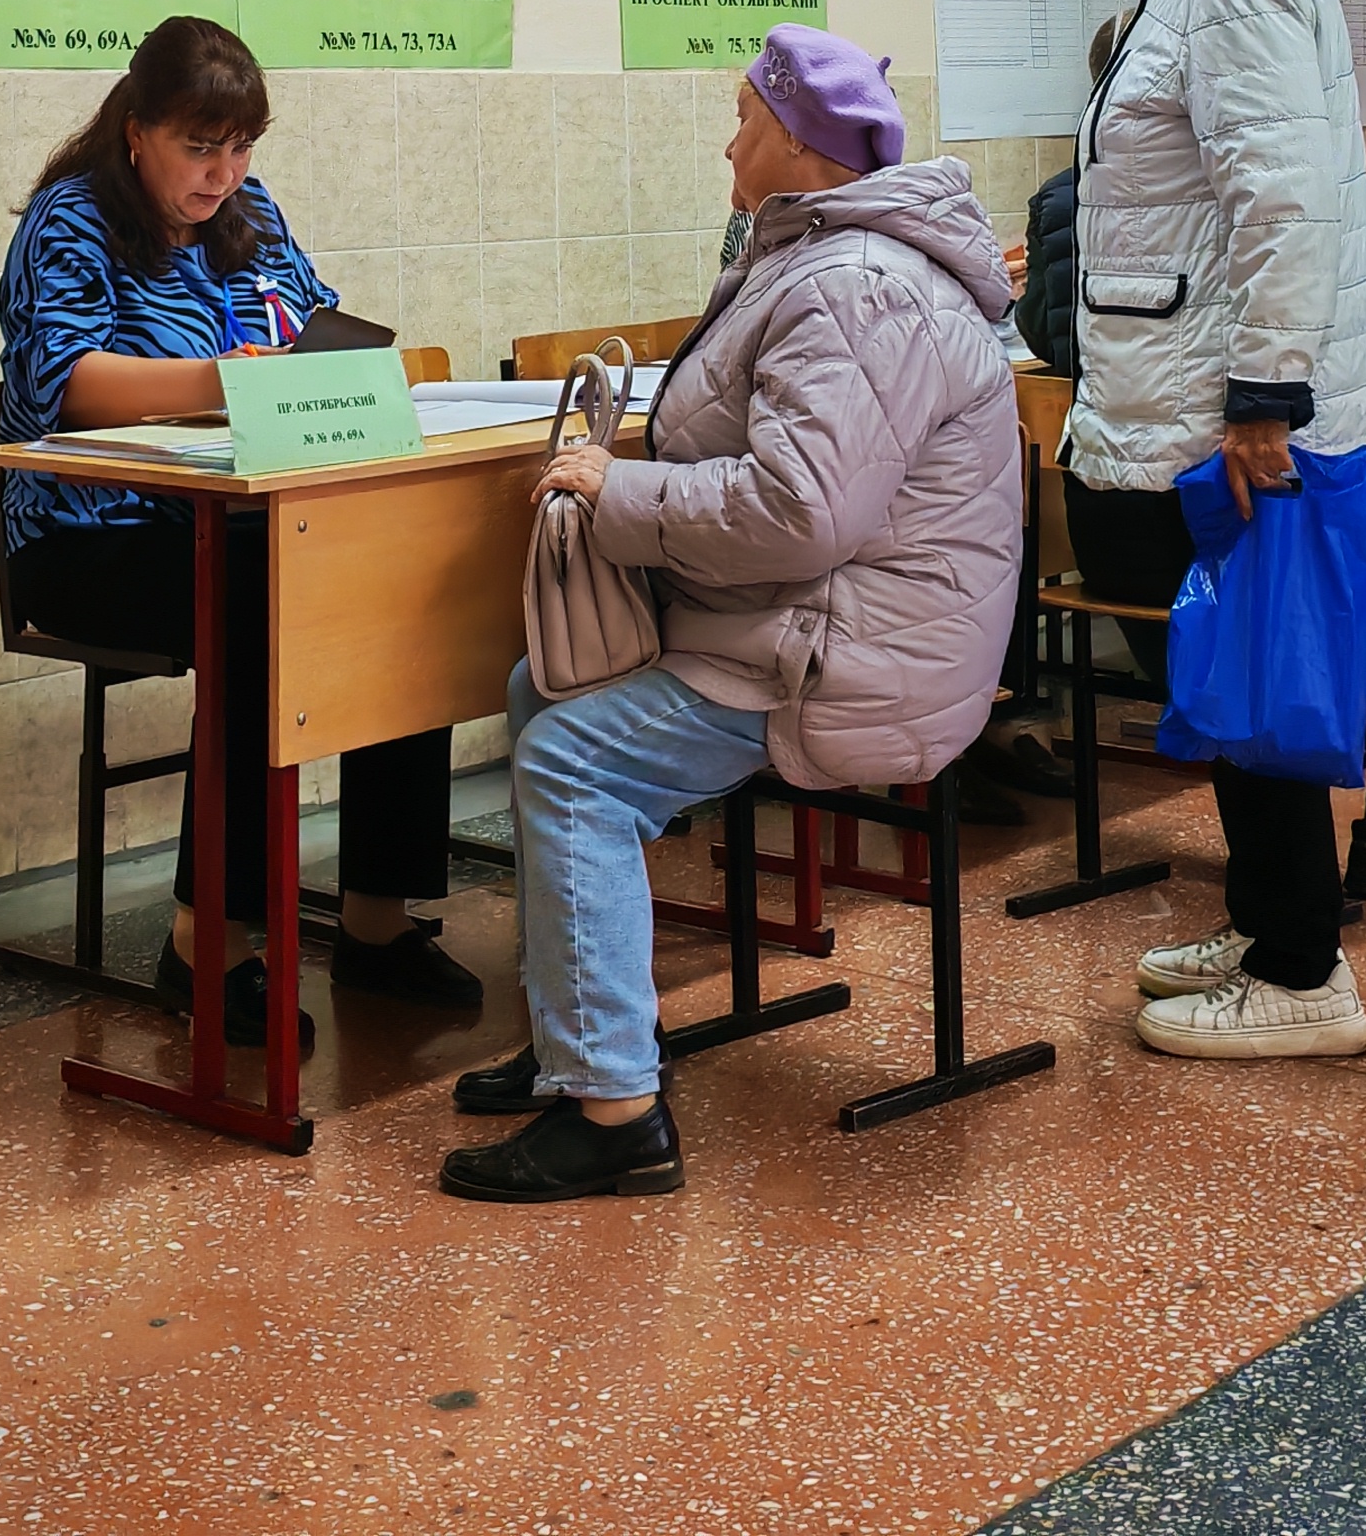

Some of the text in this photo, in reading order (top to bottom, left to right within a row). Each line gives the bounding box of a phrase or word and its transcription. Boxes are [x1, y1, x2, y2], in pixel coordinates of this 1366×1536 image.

[65, 29, 92, 53] 69,
[362, 32, 398, 53] 71А,
[402, 32, 423, 53] 73,
[428, 33, 457, 51] 73А
[728, 38, 745, 56] 75,
[298, 393, 376, 413] ОКТЯБРЬСКИЙ
[331, 431, 345, 444] 69,
[347, 428, 365, 441] 69А
